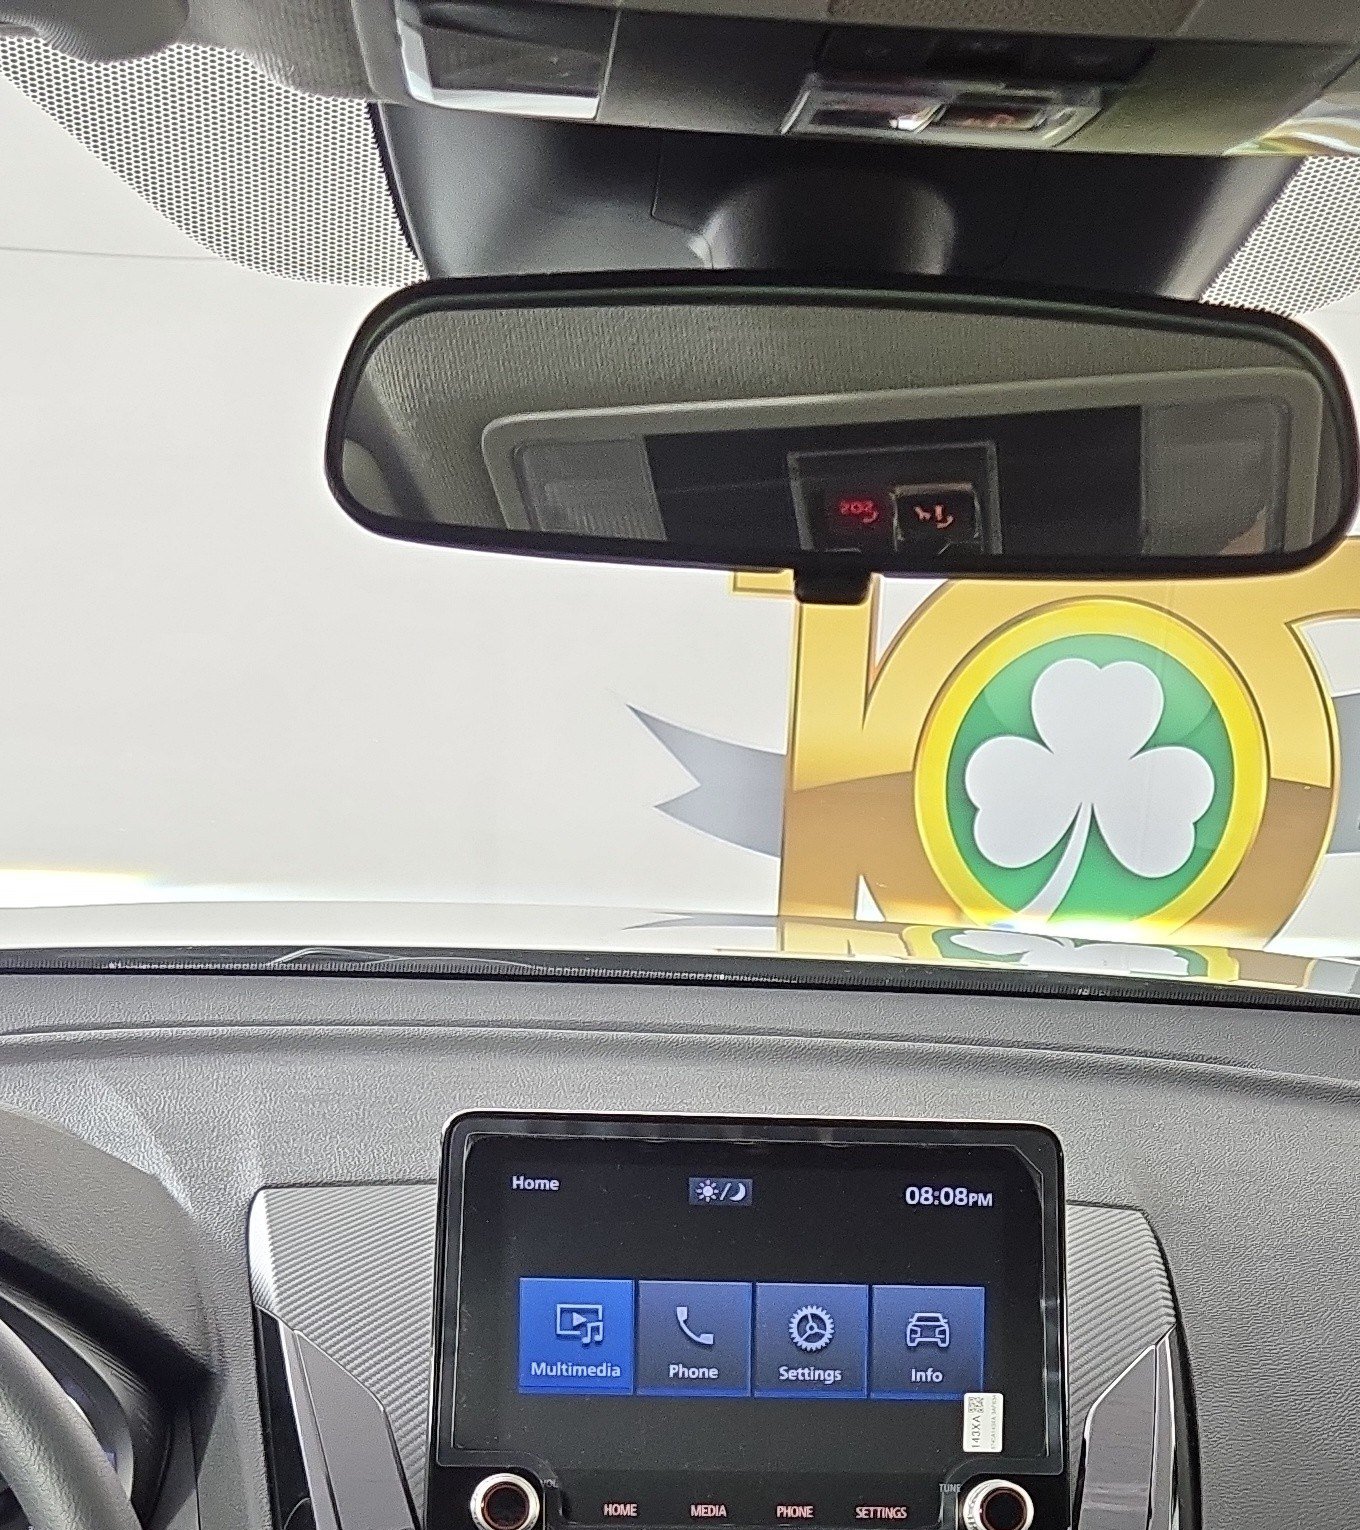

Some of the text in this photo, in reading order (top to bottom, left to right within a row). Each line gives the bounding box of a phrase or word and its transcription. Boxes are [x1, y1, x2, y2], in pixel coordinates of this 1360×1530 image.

[511, 1176, 560, 1191] Home
[530, 1360, 621, 1379] Multimedia
[669, 1363, 719, 1381] Phone
[778, 1365, 842, 1385] Settings
[910, 1367, 943, 1384] Info
[603, 1503, 638, 1517] HOME
[691, 1504, 727, 1517] MEDIA
[776, 1504, 814, 1519] PHONE
[855, 1505, 907, 1520] SETTINGS
